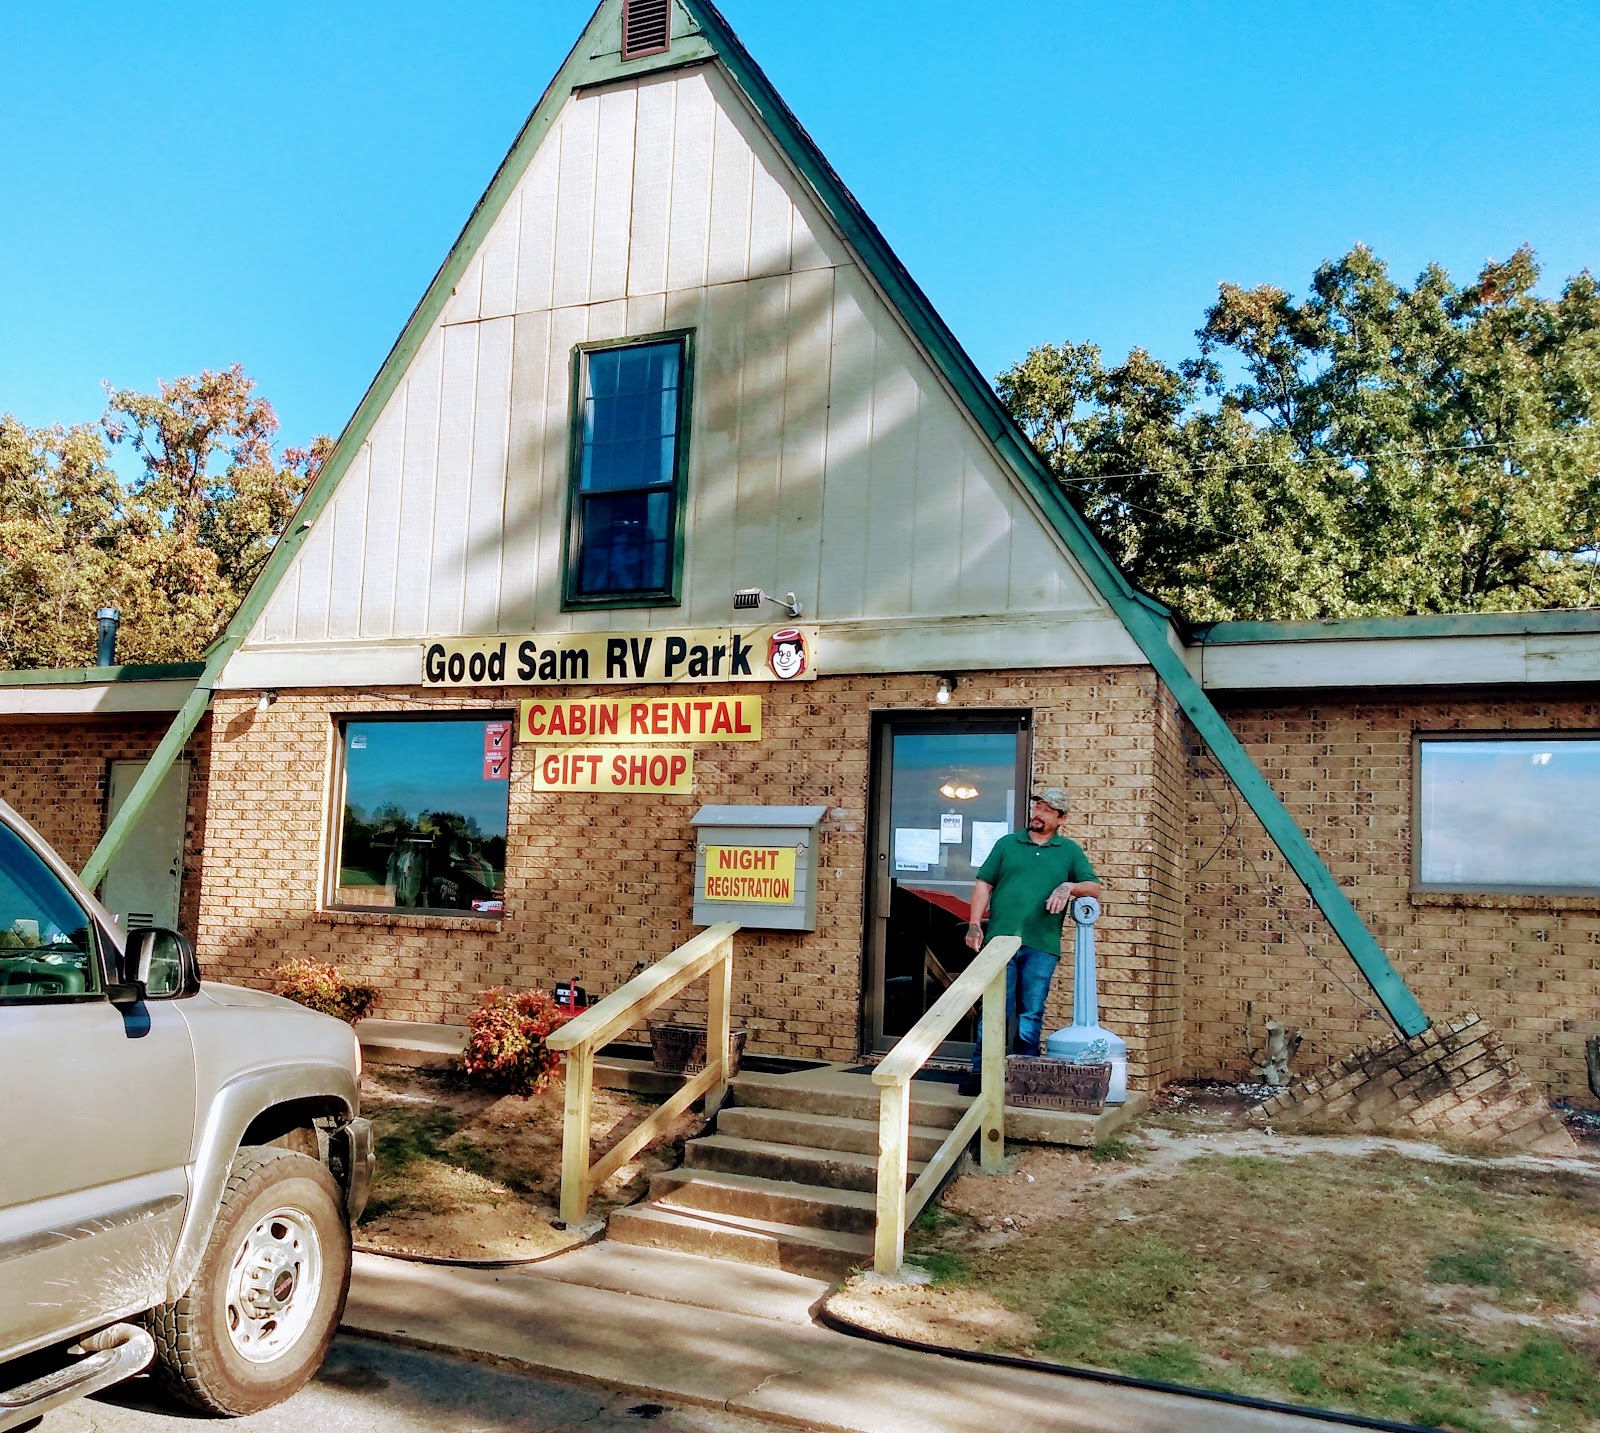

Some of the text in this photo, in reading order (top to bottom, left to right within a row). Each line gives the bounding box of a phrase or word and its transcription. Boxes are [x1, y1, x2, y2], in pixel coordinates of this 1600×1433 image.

[426, 635, 754, 682] Good Sam RV Park
[527, 701, 752, 736] CABIN RENTAL
[542, 754, 687, 786] GIFT SHOP
[719, 849, 779, 870] NIGHT
[707, 876, 790, 898] REGISTRATION
